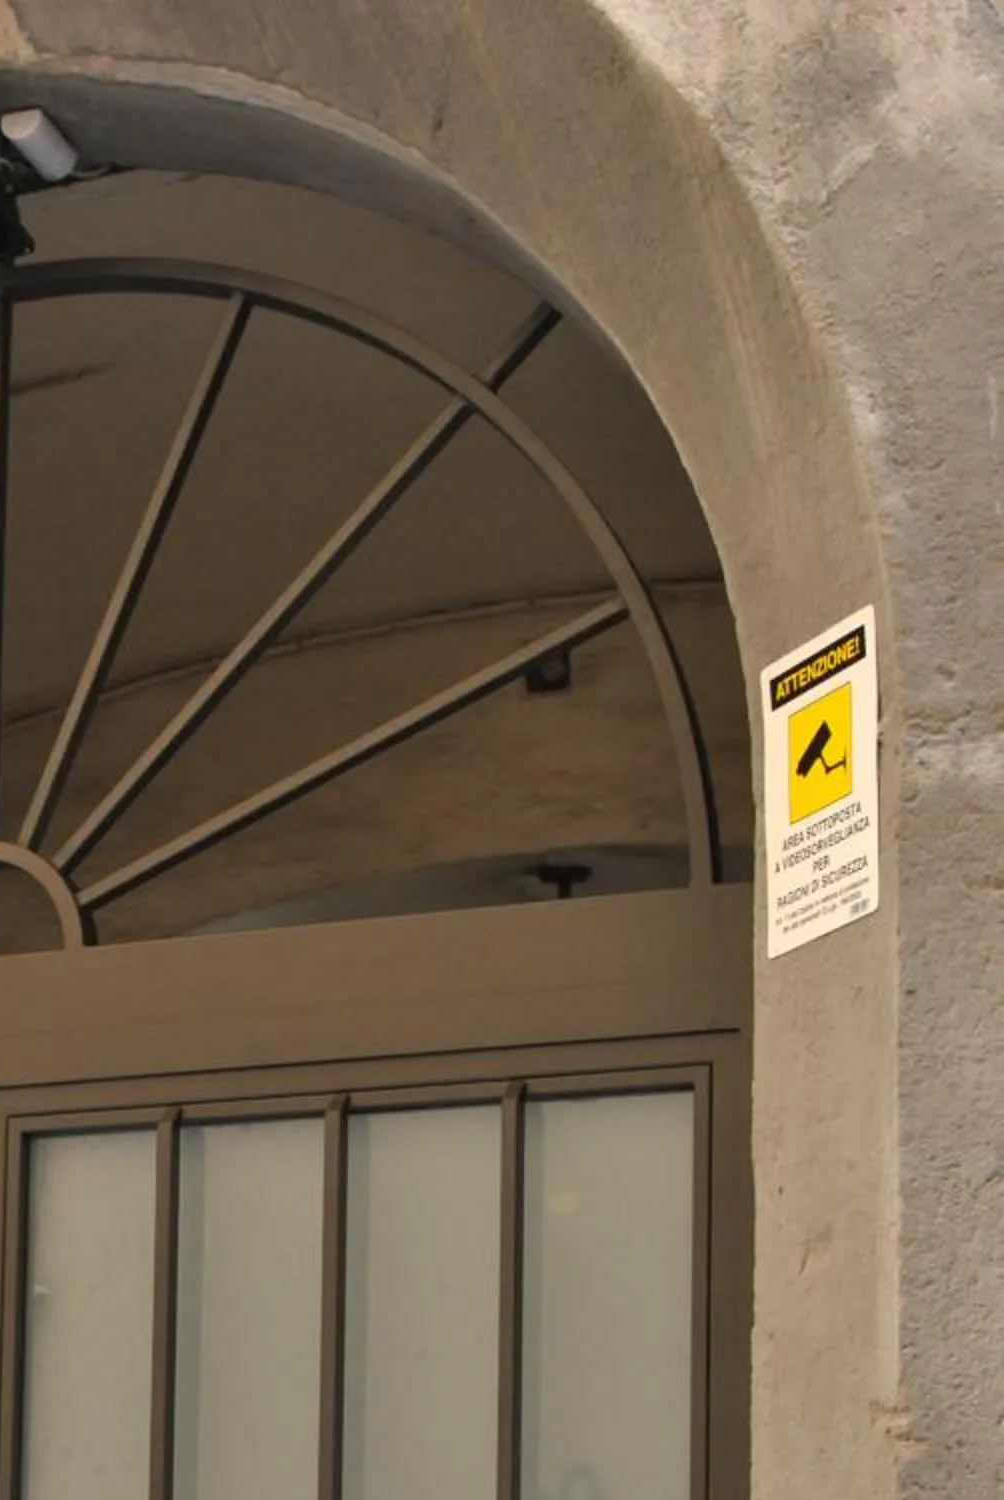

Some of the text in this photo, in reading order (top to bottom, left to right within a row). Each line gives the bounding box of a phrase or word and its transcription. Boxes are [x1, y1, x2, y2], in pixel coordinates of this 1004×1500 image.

[776, 635, 860, 701] ATTENZIONE!
[783, 802, 862, 852] AREA SOTTOPOSTA
[783, 816, 870, 870] VIDEOSORVEGLIANZA
[777, 883, 809, 908] RAGIONI
[811, 878, 819, 894] DI
[821, 856, 869, 889] SICUREZZA
[813, 855, 830, 872] PER
